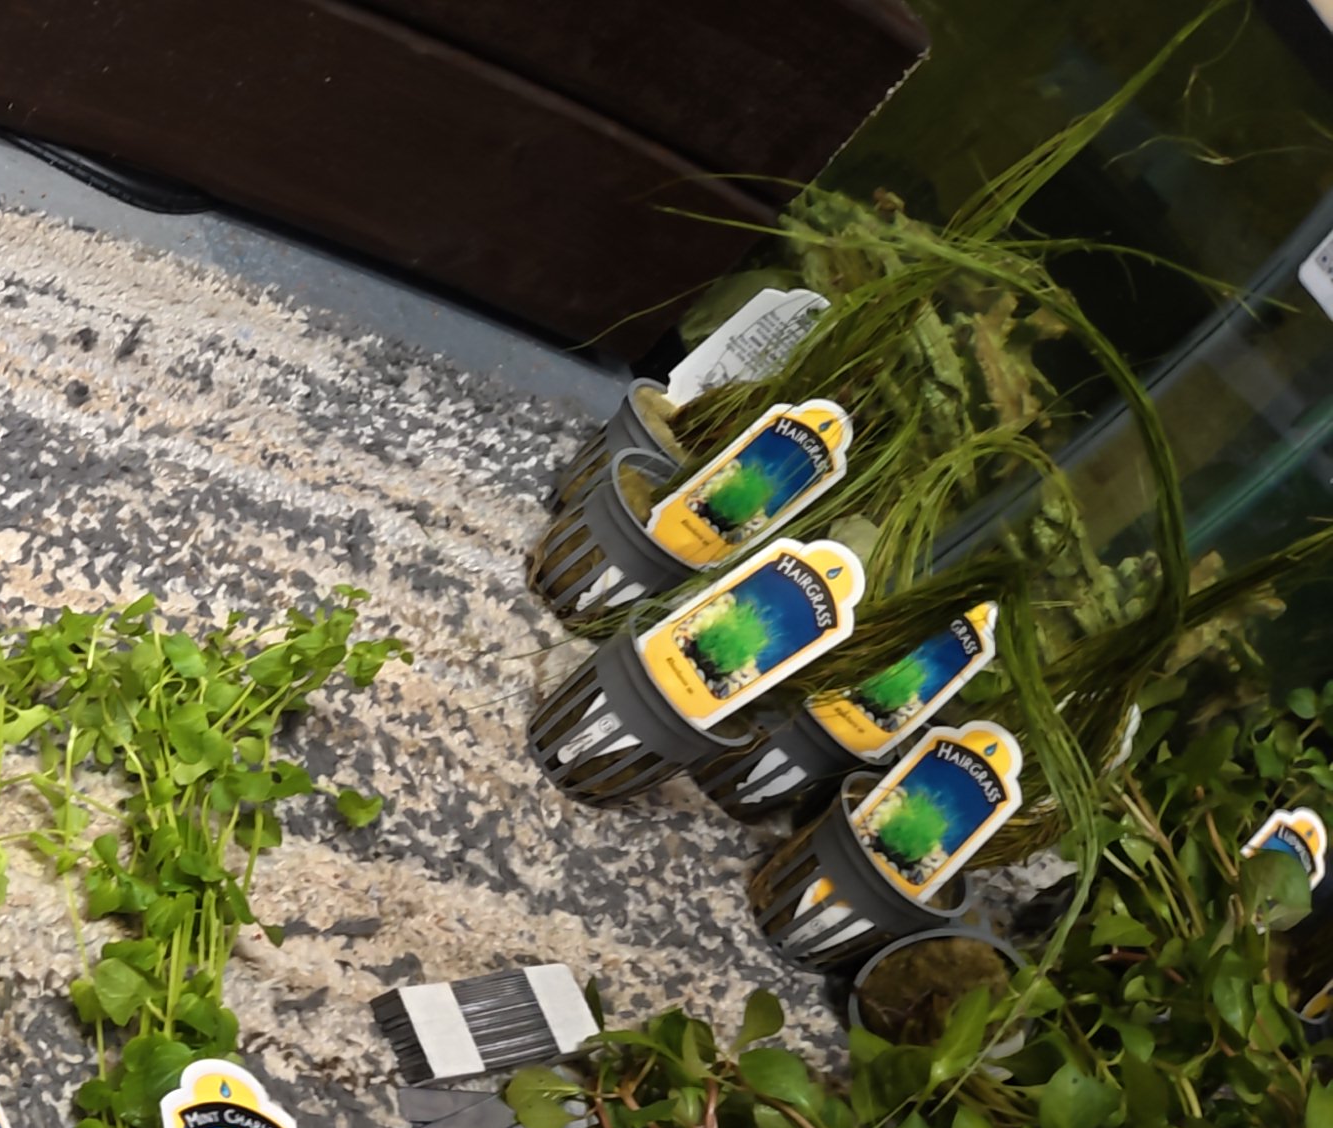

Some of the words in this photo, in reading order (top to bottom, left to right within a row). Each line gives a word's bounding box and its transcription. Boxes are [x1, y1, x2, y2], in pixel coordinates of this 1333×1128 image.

[776, 555, 832, 627] HAIRGRASS
[936, 742, 1002, 803] HAIRGRASS
[184, 1109, 219, 1128] MINT
